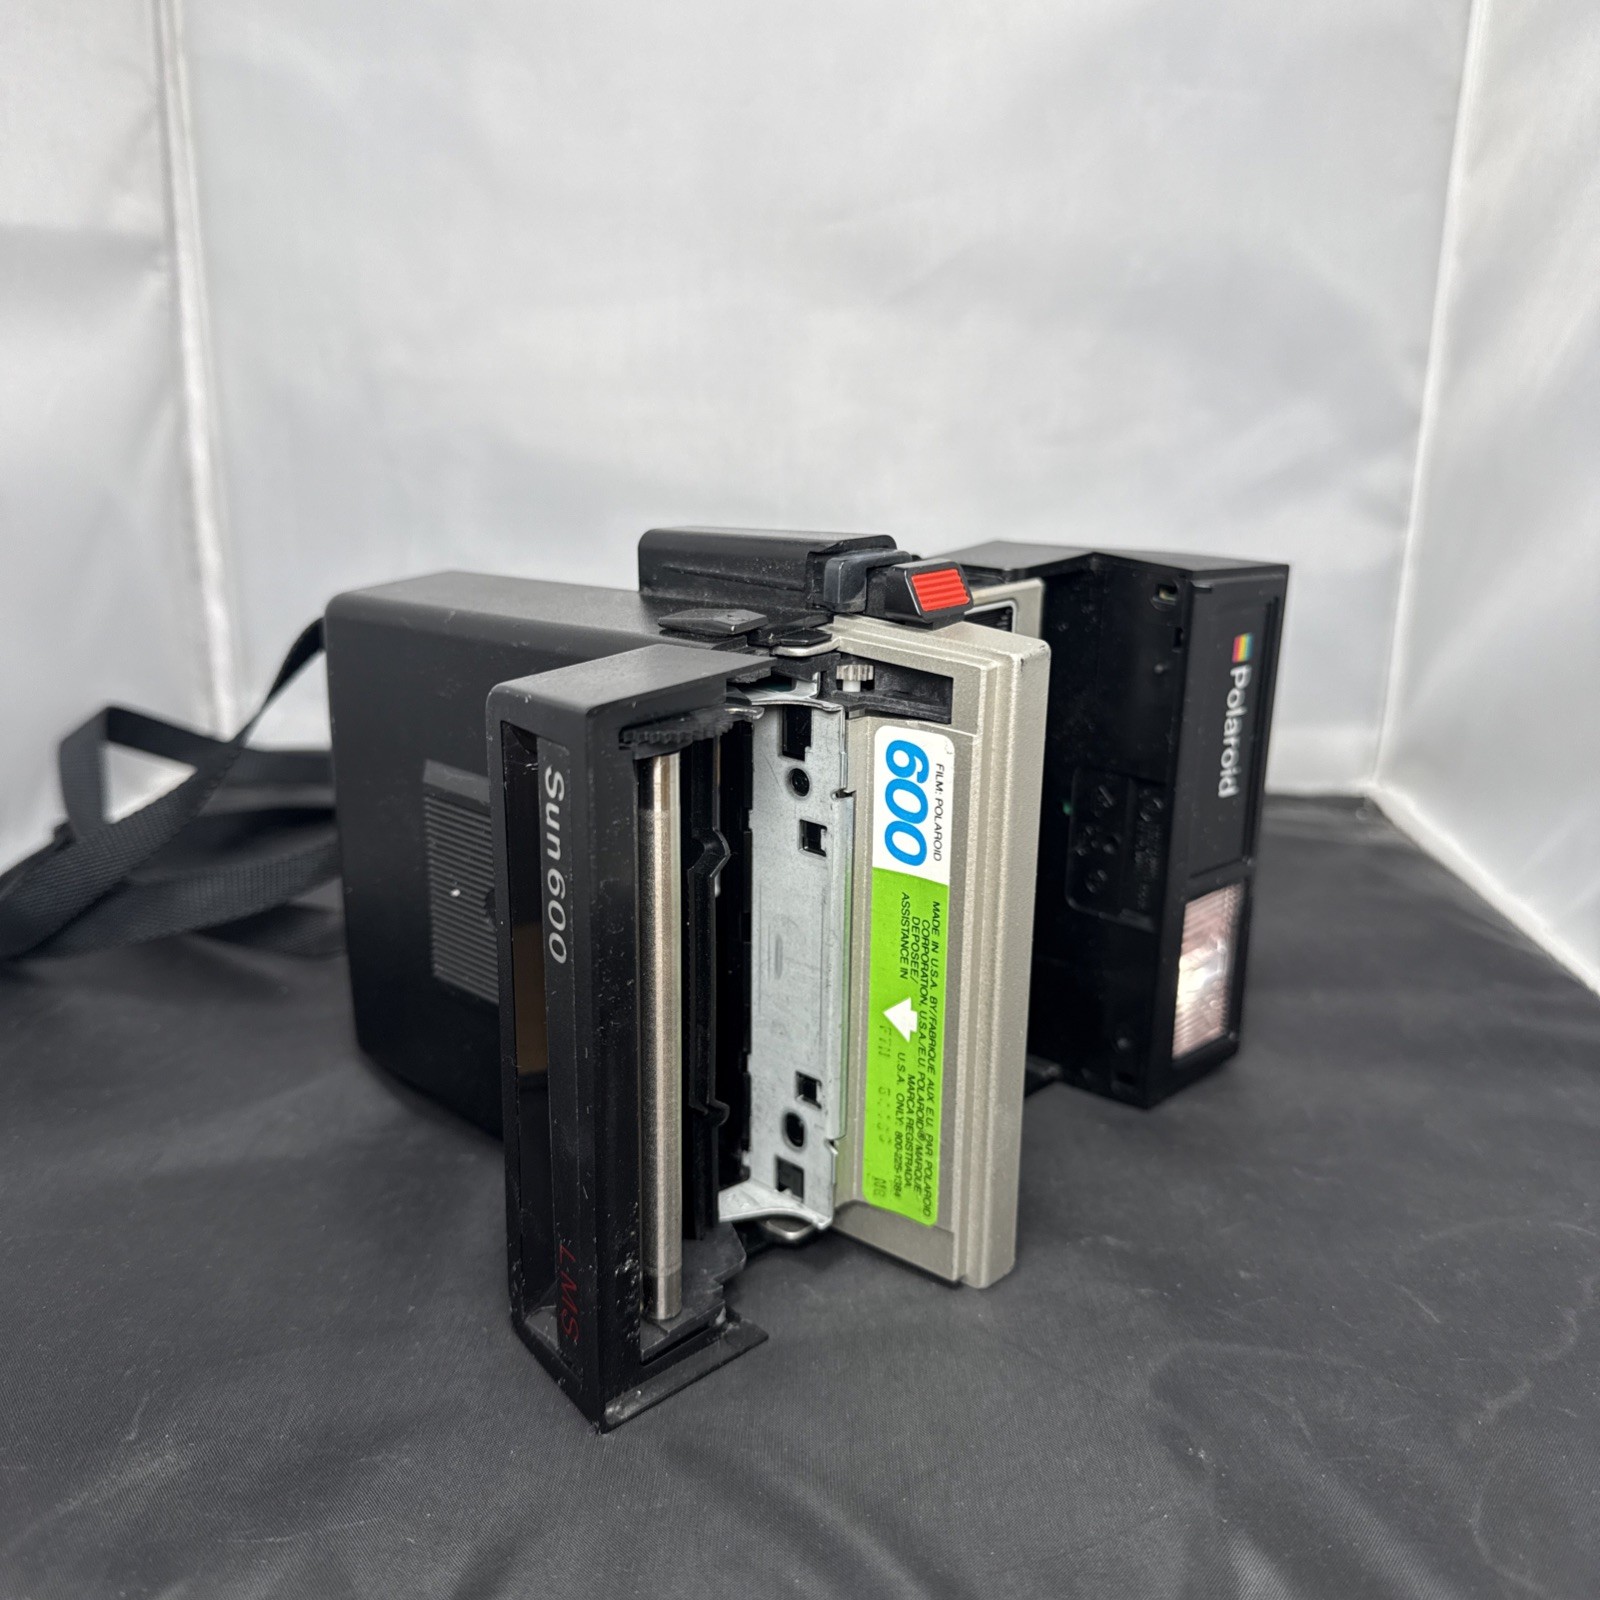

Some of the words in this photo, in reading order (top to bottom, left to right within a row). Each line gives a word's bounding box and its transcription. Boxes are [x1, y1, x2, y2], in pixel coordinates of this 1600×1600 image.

[1218, 664, 1252, 798] Polaroid
[934, 763, 945, 794] FILM:
[884, 739, 930, 866] 600
[933, 798, 944, 861] POLAROID
[899, 892, 911, 964] ASSISTANCE
[931, 901, 941, 937] MADE
[909, 916, 921, 984] DEPOSEE/
[918, 919, 931, 1007] CORPORATION,
[930, 940, 940, 953] IN
[899, 967, 909, 980] IN
[930, 958, 939, 990] U.S.A.
[896, 1052, 906, 1086] U.S.A.
[926, 1078, 935, 1101] AUX
[906, 1074, 916, 1115] MARCA
[925, 1133, 934, 1156] PAR
[923, 1159, 934, 1218] POLAROID
[559, 1243, 579, 1341] LMS
